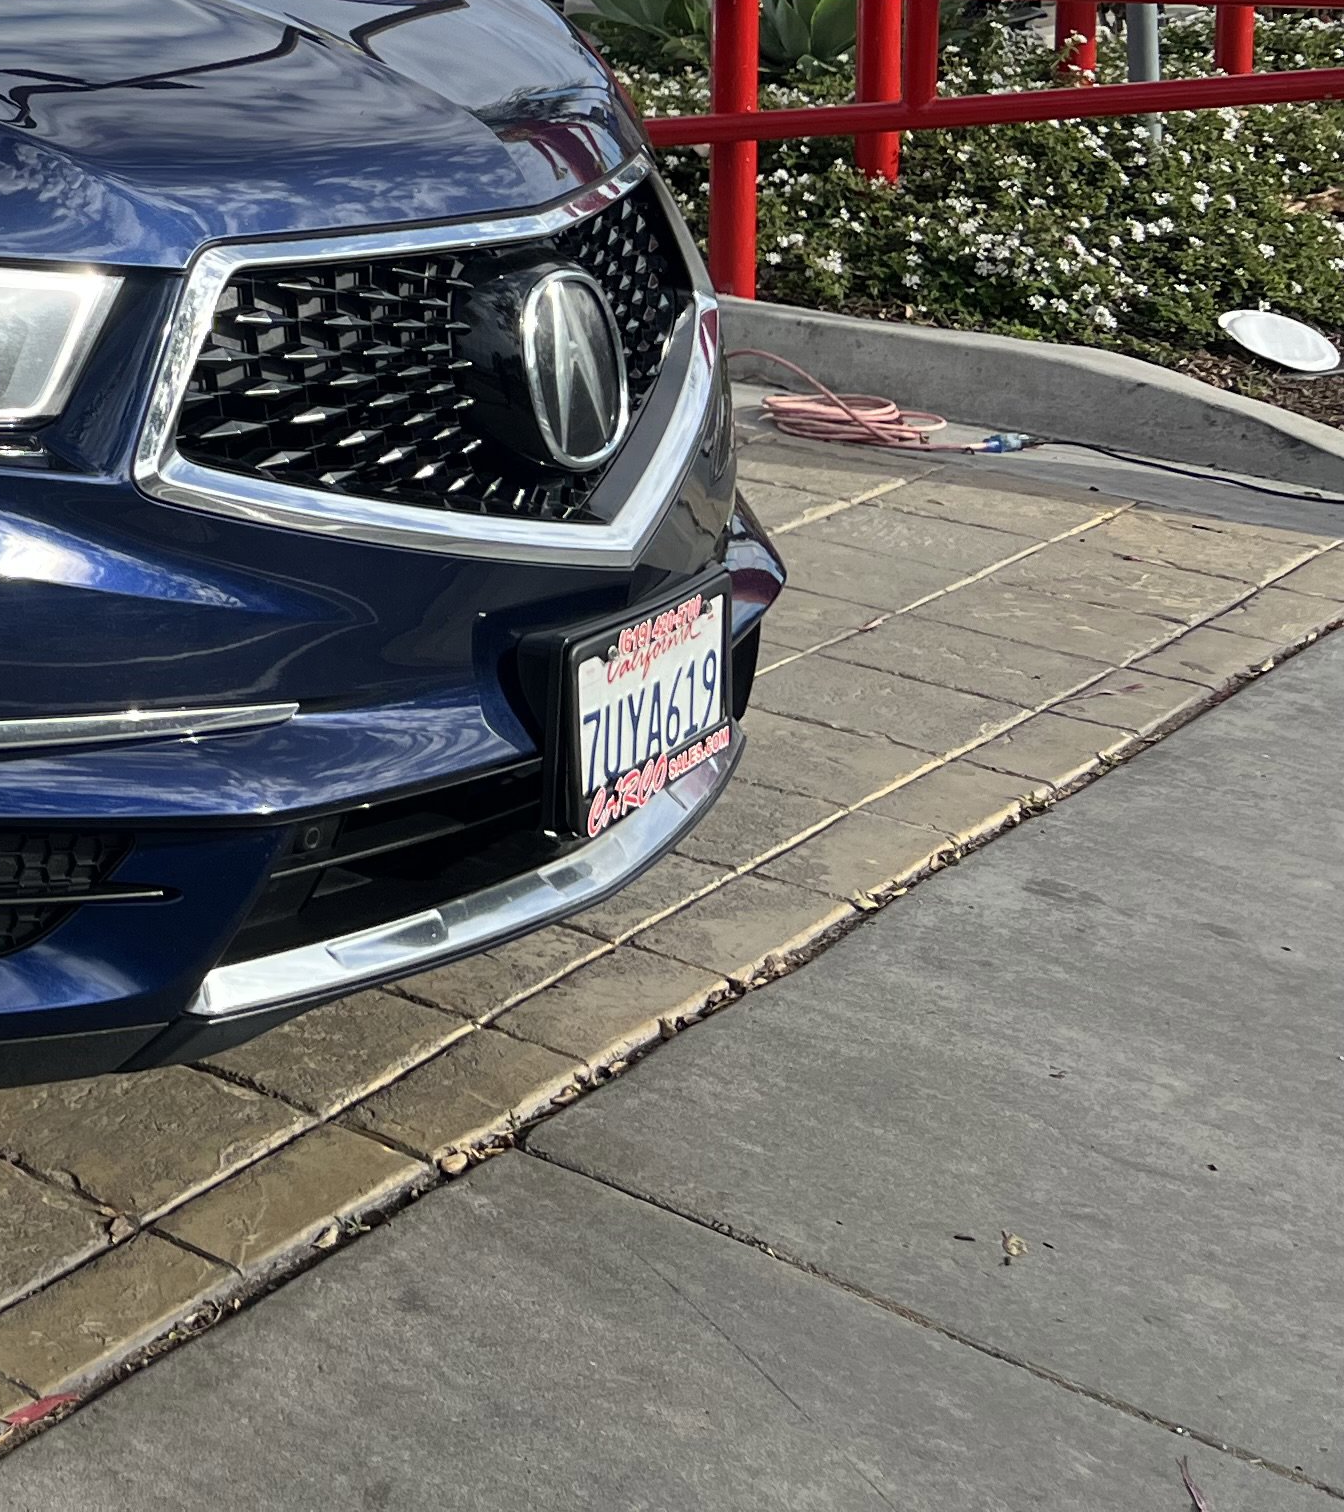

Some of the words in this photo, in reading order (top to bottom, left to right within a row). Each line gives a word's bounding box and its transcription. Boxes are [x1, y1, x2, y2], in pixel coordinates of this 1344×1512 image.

[607, 622, 701, 685] California
[618, 618, 653, 656] (619)
[582, 648, 717, 798] 7UYA619
[668, 726, 730, 780] SALES.COM
